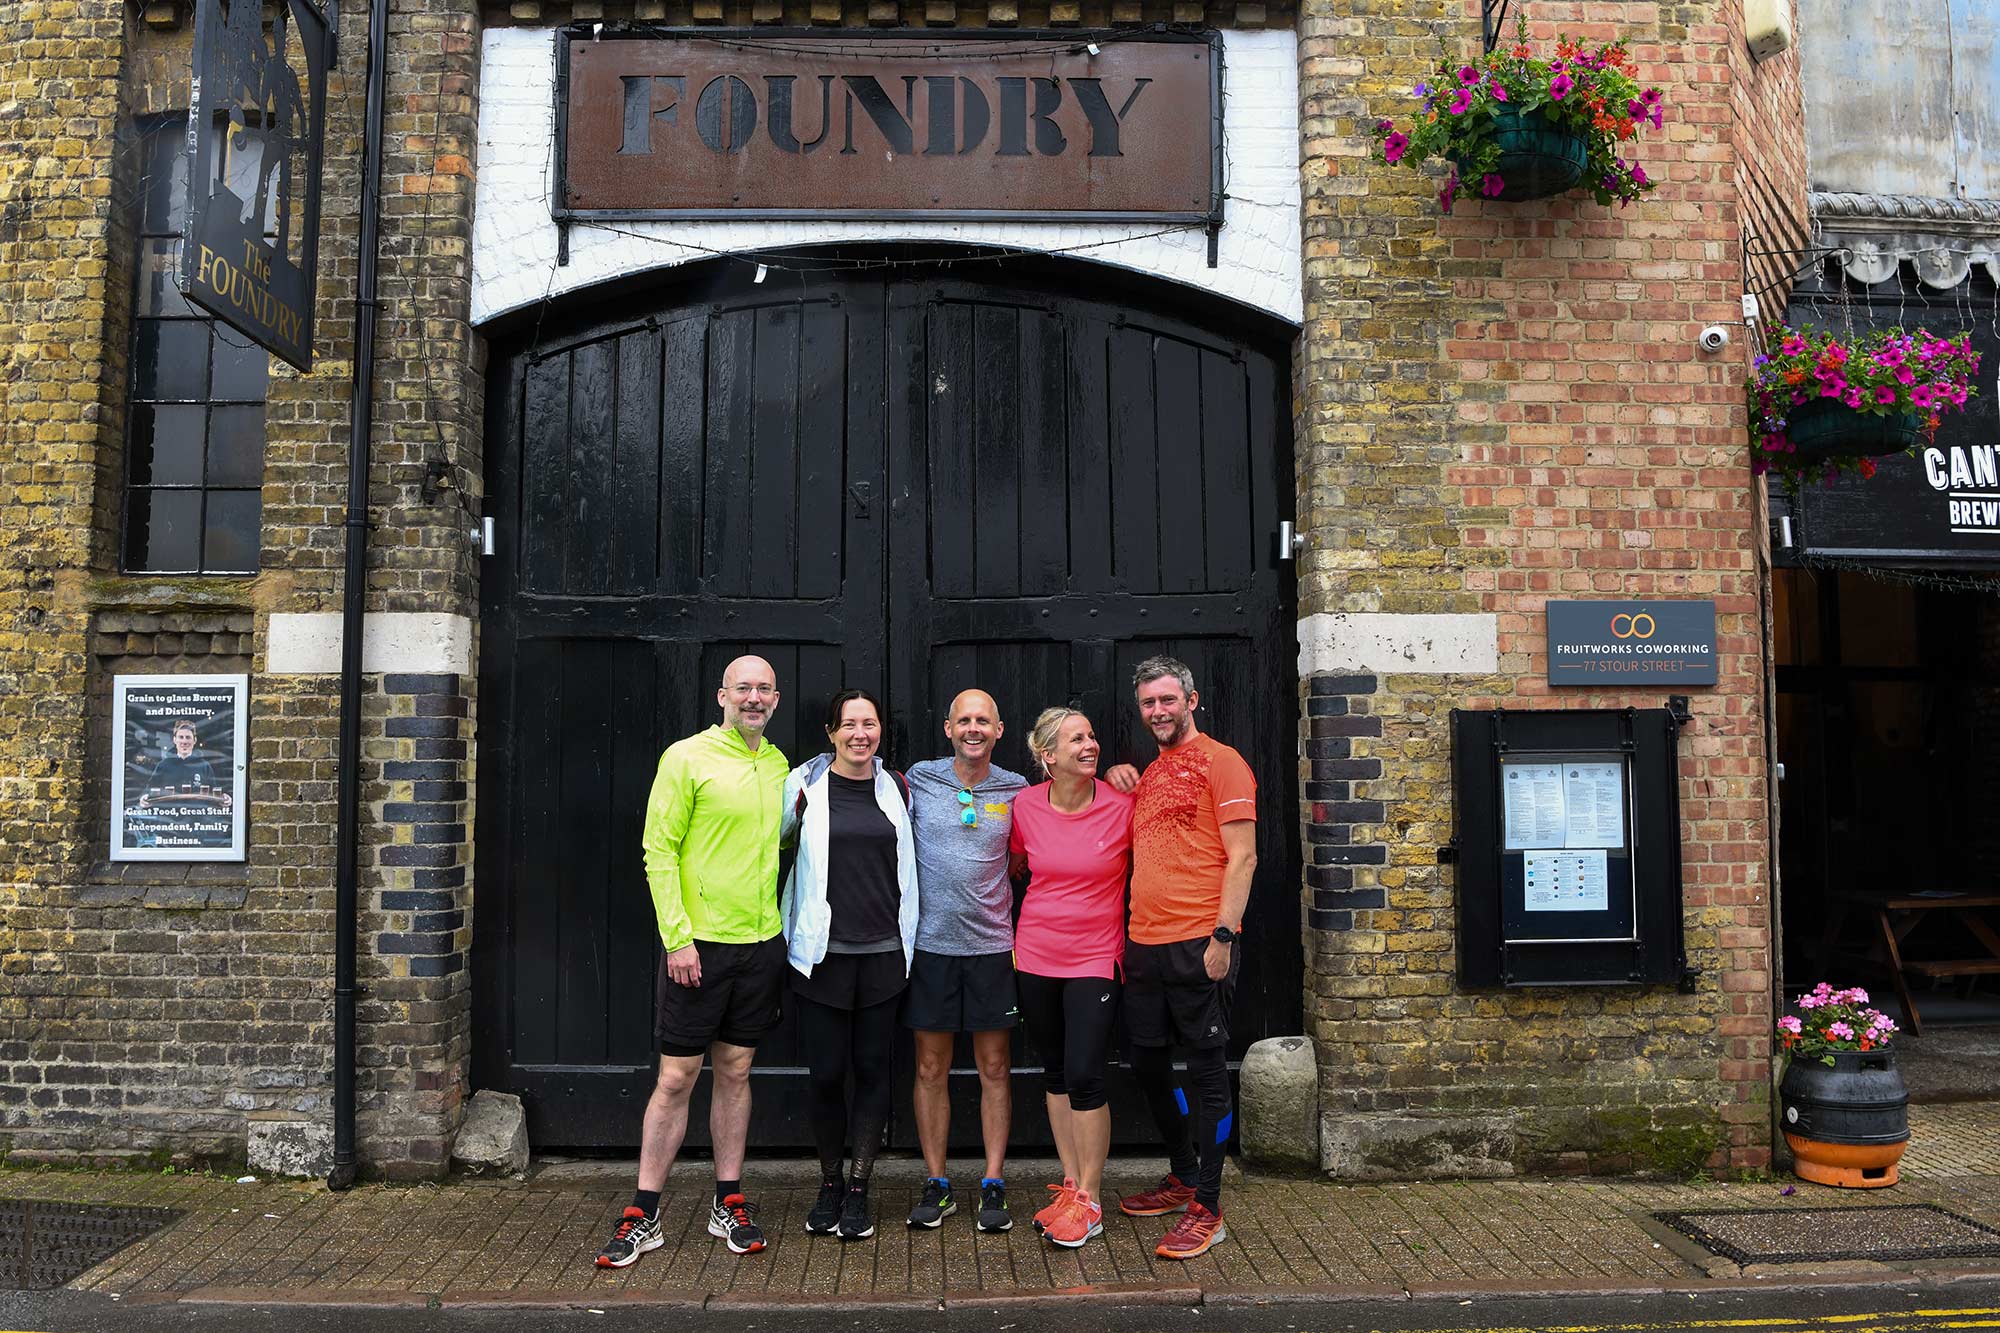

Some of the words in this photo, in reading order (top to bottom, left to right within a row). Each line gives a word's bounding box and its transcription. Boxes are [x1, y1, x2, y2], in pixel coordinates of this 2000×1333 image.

[616, 75, 1153, 157] FOUNDRY
[243, 238, 271, 284] The
[196, 243, 302, 347] FOUNDRY
[1949, 500, 2000, 526] BREW
[1557, 644, 1632, 654] FRUITWORKS
[1636, 644, 1709, 654] COWORKING
[1583, 660, 1596, 672] 77
[1600, 660, 1638, 672] STOUR
[1642, 660, 1684, 672] STREET
[127, 694, 154, 703] Grain
[156, 695, 165, 703] to
[167, 694, 191, 703] glass
[193, 693, 233, 703] Brewery
[145, 707, 164, 716] and
[165, 707, 215, 716] Distillery.
[126, 807, 152, 816] Great
[153, 807, 179, 817] Food,
[180, 807, 206, 815] Great
[207, 806, 233, 816] Staff.
[128, 822, 193, 832] Independent,
[194, 822, 229, 832] Family
[156, 836, 201, 845] Business.
